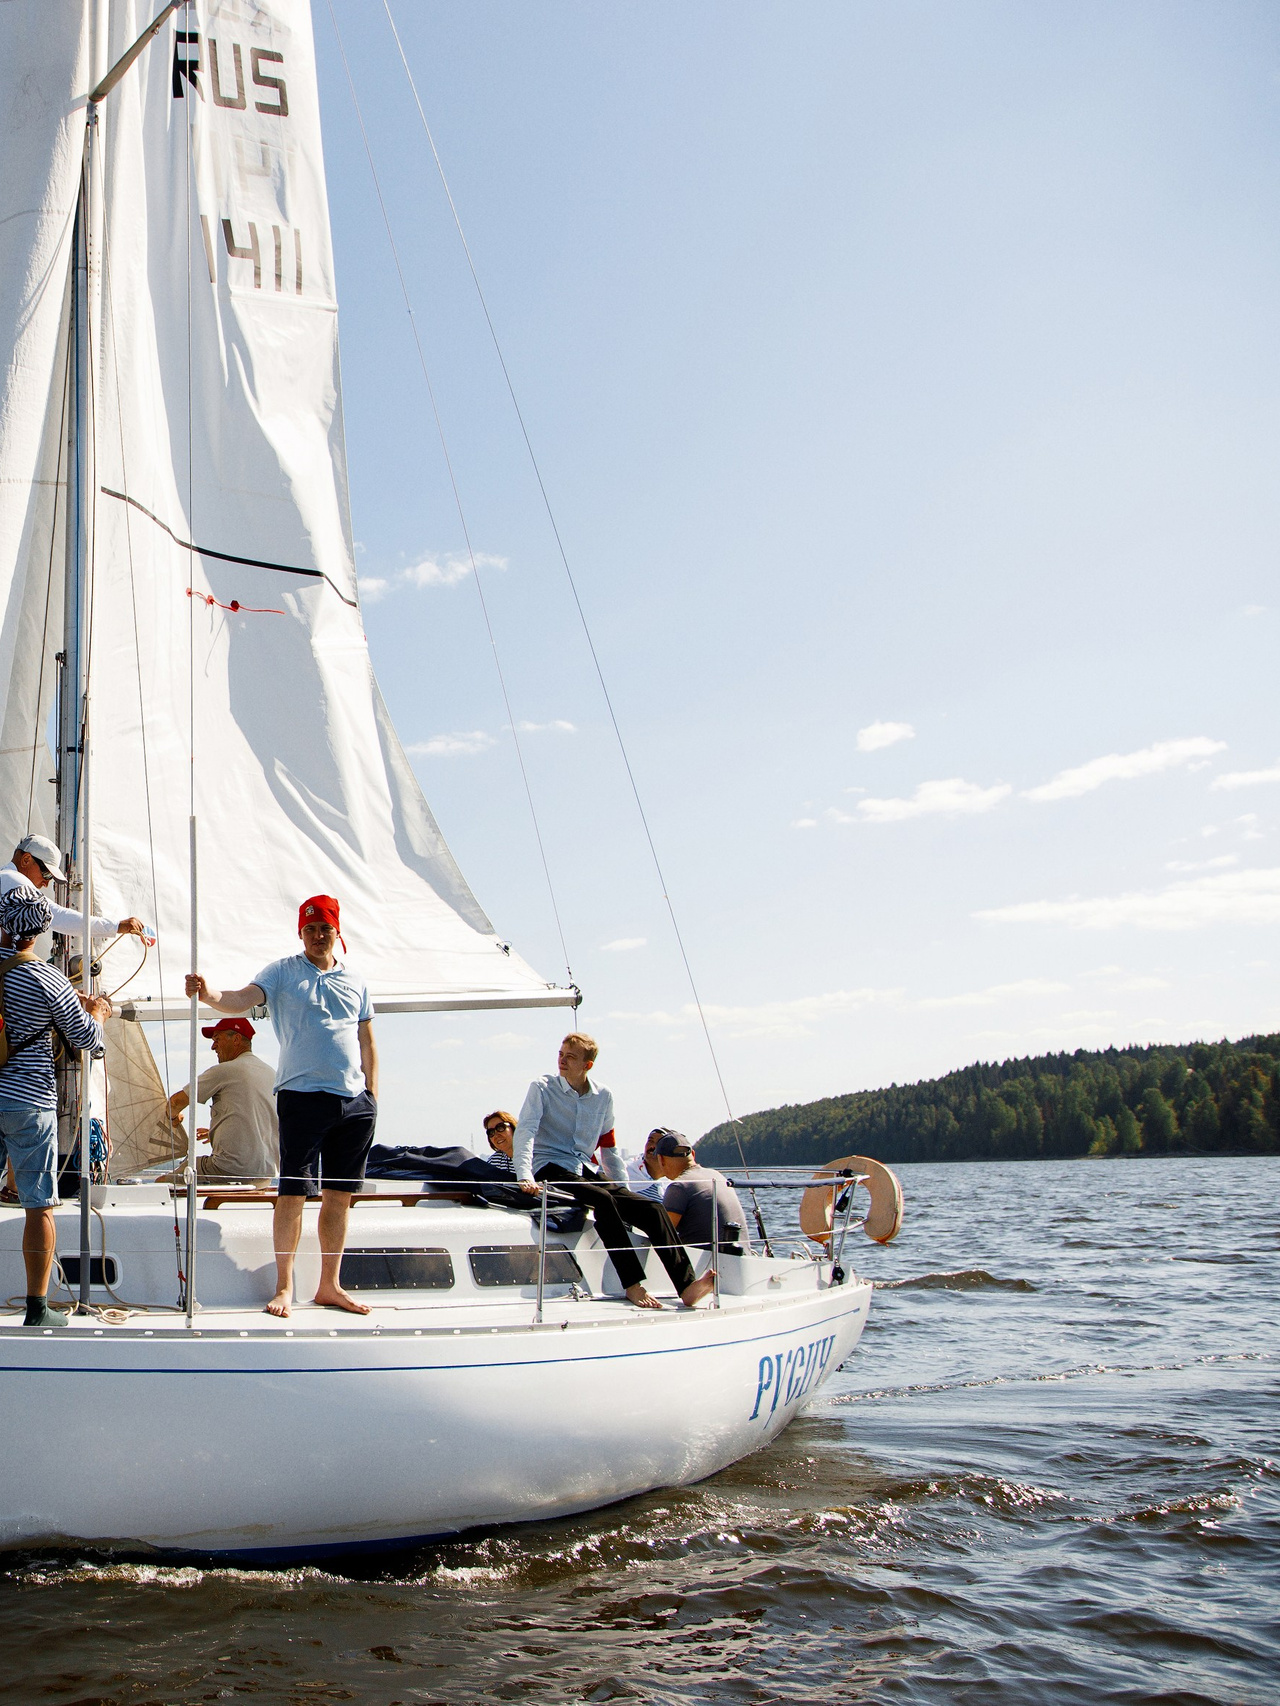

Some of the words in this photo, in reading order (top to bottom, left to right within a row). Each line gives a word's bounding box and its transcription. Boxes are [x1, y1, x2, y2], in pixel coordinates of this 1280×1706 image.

[172, 29, 289, 117] RUS
[199, 214, 303, 296] 1411
[748, 1334, 837, 1430] РУСИЧ
